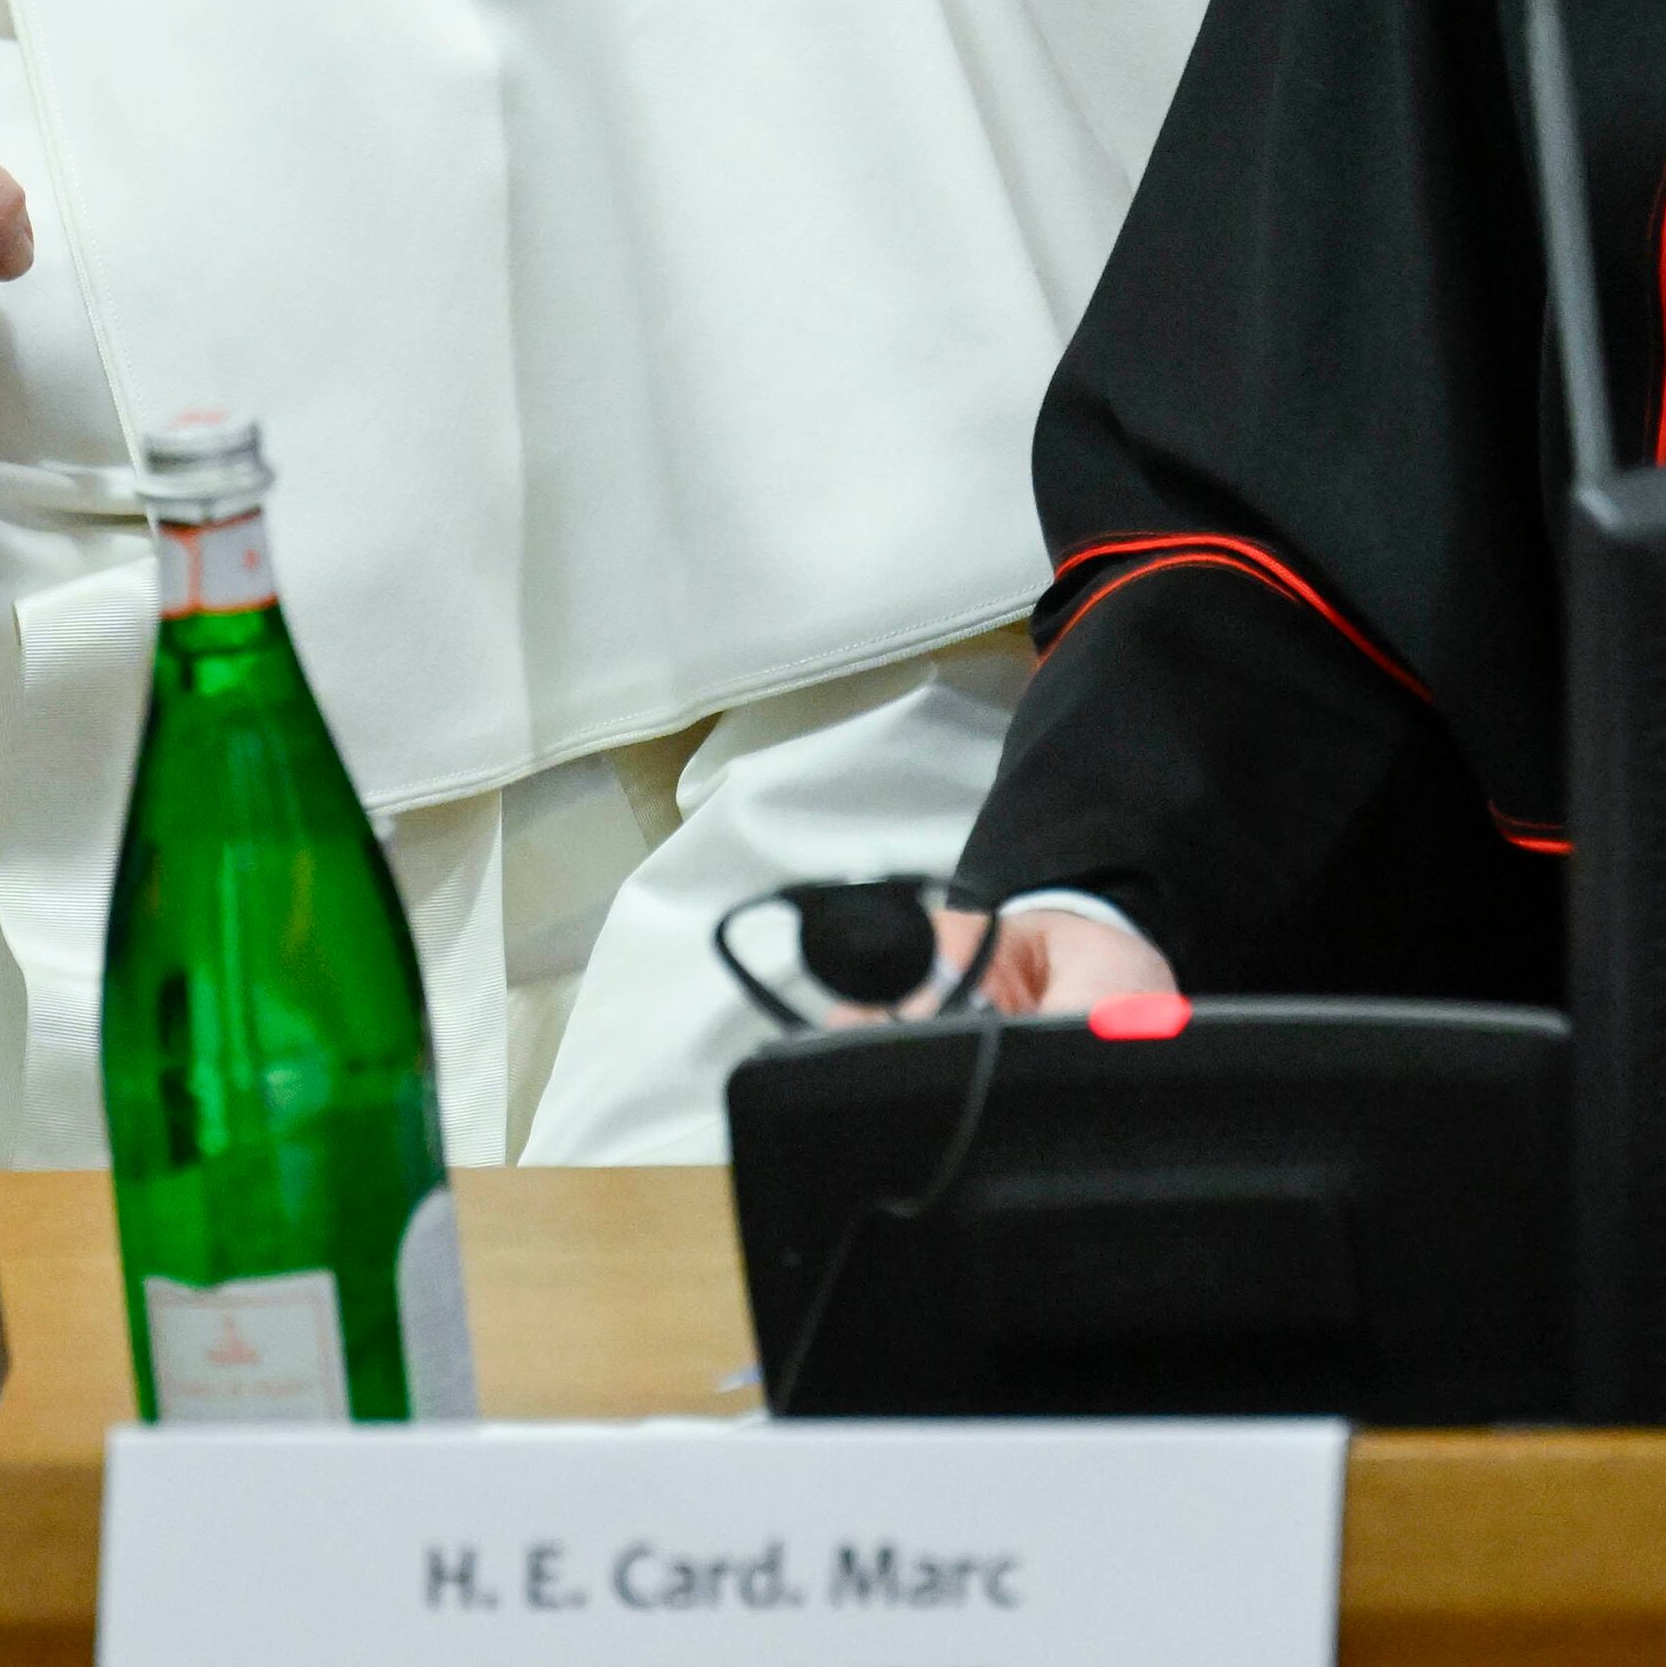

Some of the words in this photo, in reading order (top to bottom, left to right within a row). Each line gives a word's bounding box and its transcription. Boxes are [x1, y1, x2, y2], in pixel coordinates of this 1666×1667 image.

[423, 1543, 500, 1612] H.
[525, 1543, 589, 1612] E.
[612, 1539, 807, 1612] Card.
[830, 1543, 1023, 1612] Marc
